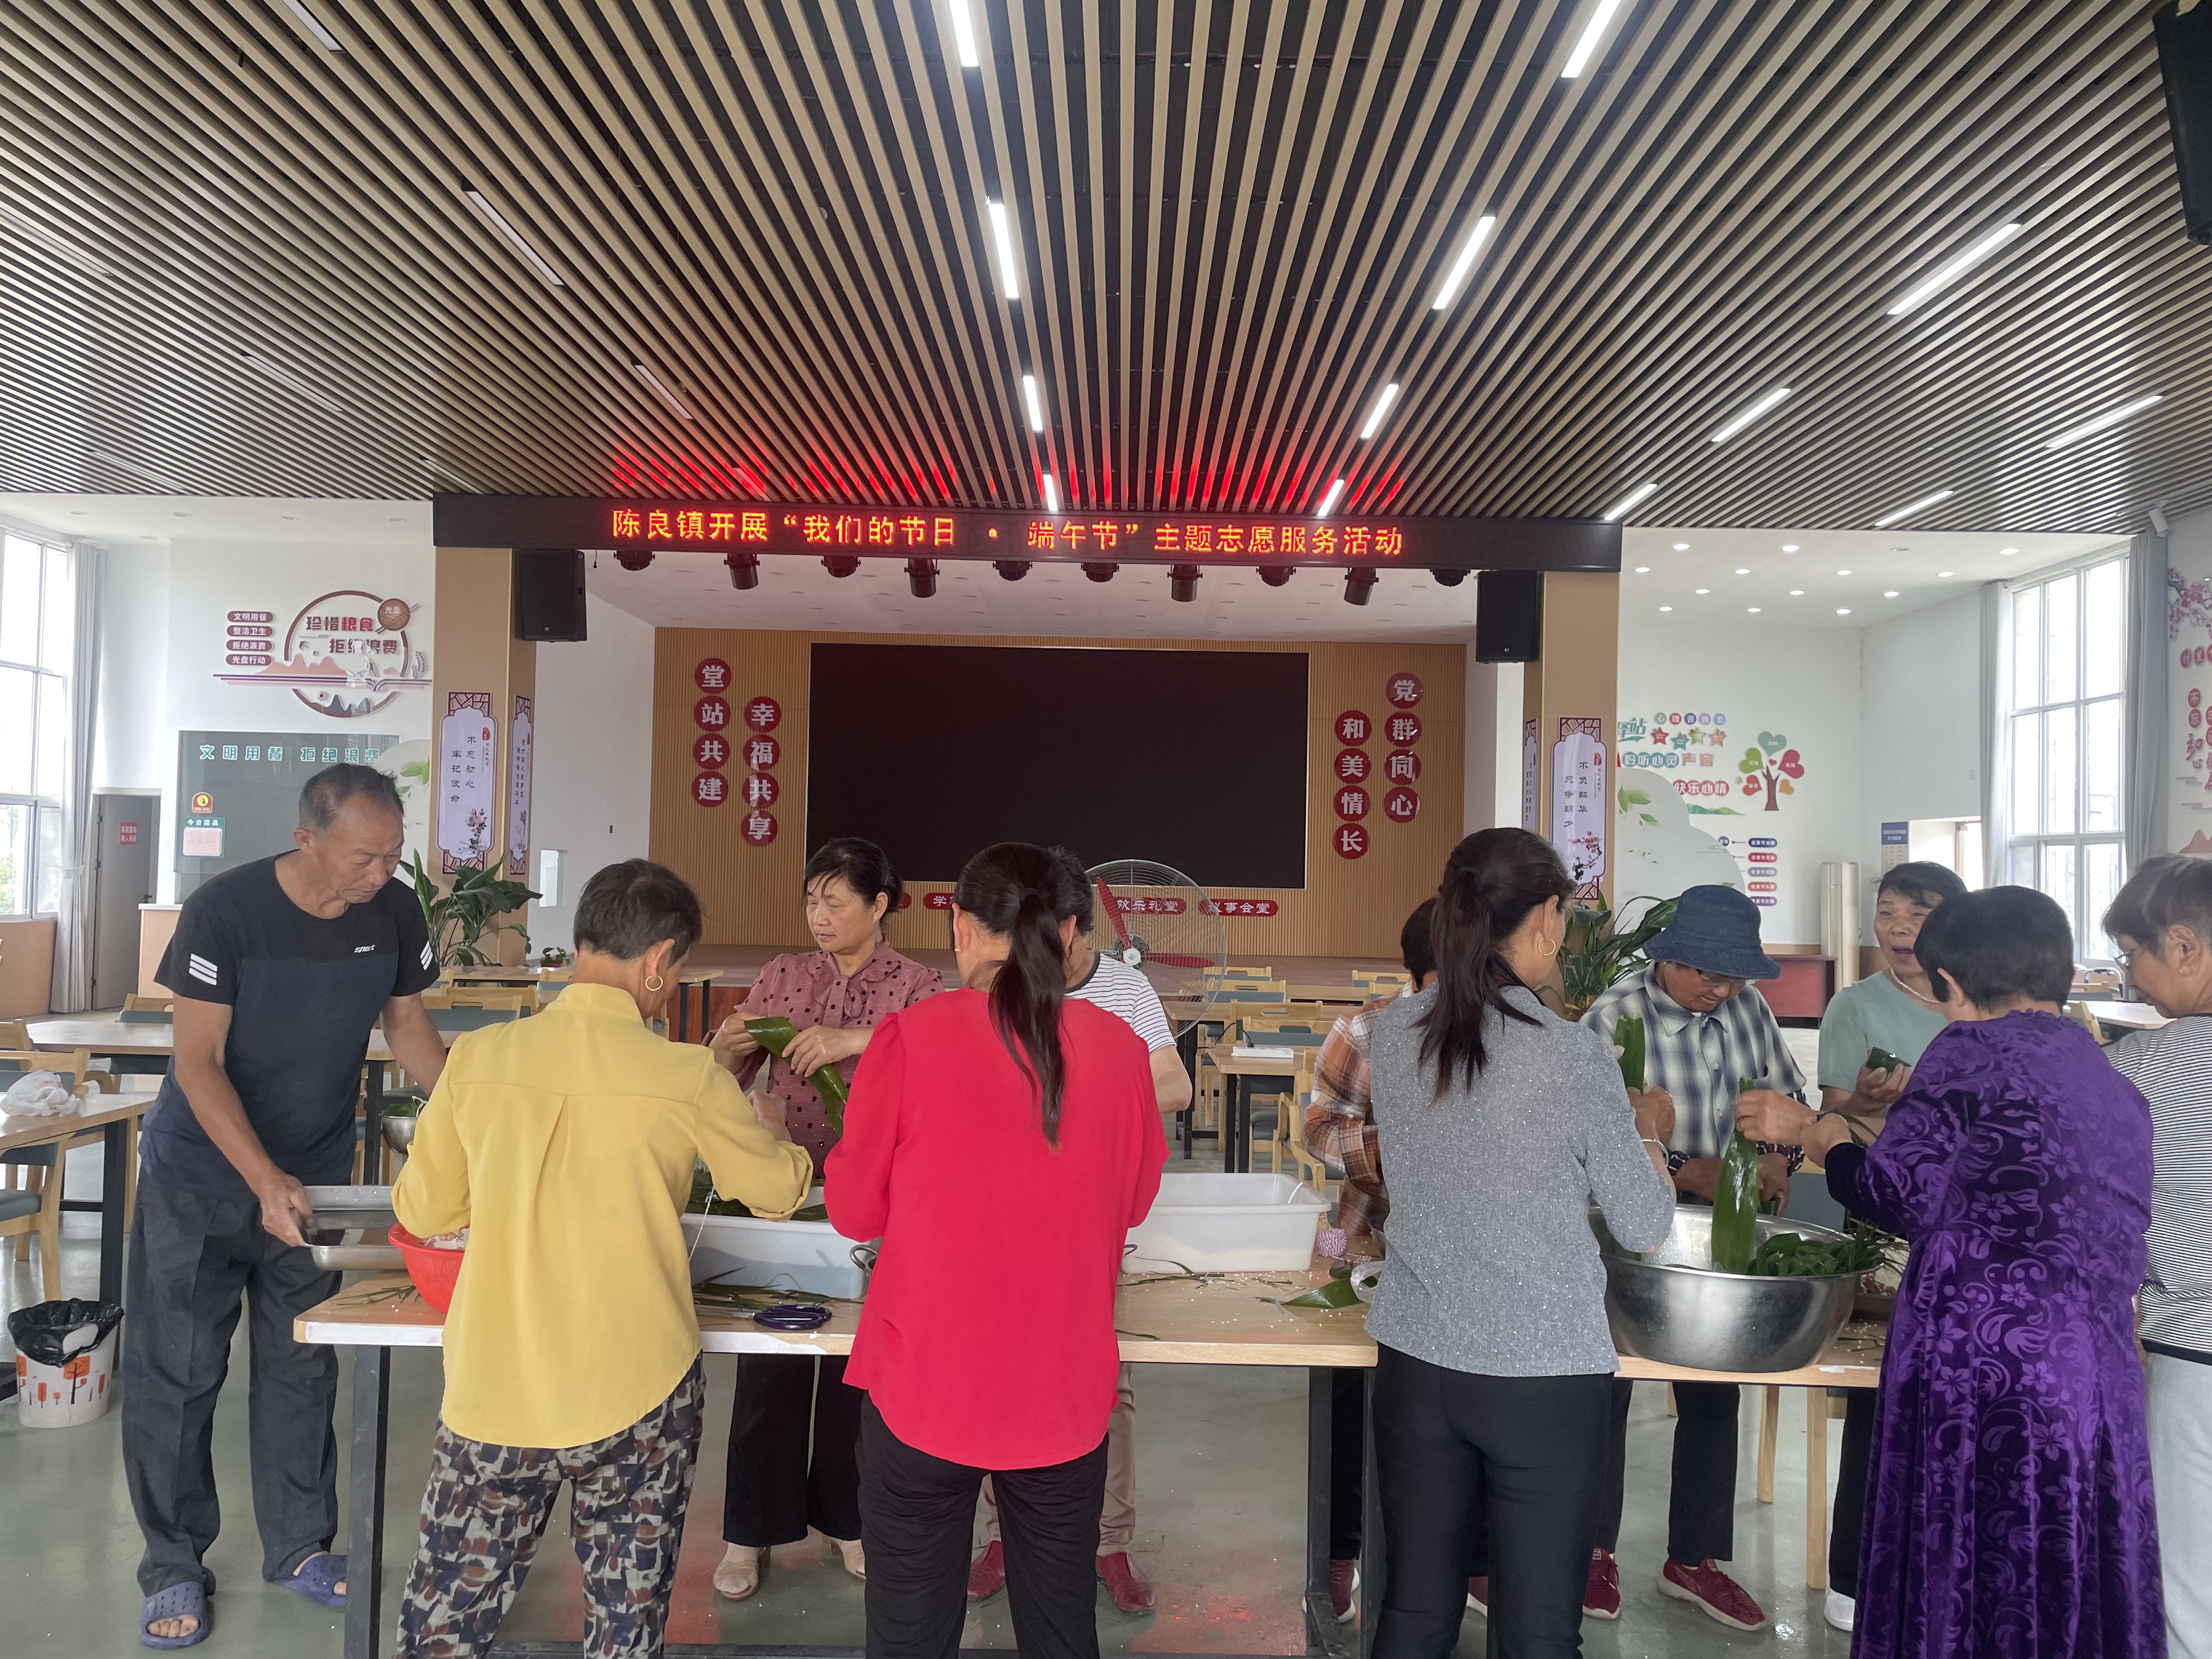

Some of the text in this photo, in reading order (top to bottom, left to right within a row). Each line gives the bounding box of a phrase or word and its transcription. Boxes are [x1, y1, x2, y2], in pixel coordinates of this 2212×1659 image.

[233, 613, 267, 621] 文明用餐
[306, 616, 374, 631] 珍惜粮食
[233, 627, 267, 635] 整洁卫生
[233, 641, 266, 650] 拒绝浪费
[232, 656, 266, 664] 光盘行动
[698, 665, 725, 800] 堂站共建
[200, 744, 380, 763] 文明用餐 拒绝浪费
[1391, 680, 1415, 815] 党群同心
[466, 737, 476, 788] 不忘初心
[748, 703, 775, 840] 幸福共享
[450, 750, 461, 803] 牢记使命
[1341, 718, 1364, 852] 和美情长
[1578, 762, 1588, 814] 不负韶华
[1675, 782, 1726, 794] 快乐心情
[1116, 899, 1178, 912] 欢乐礼堂
